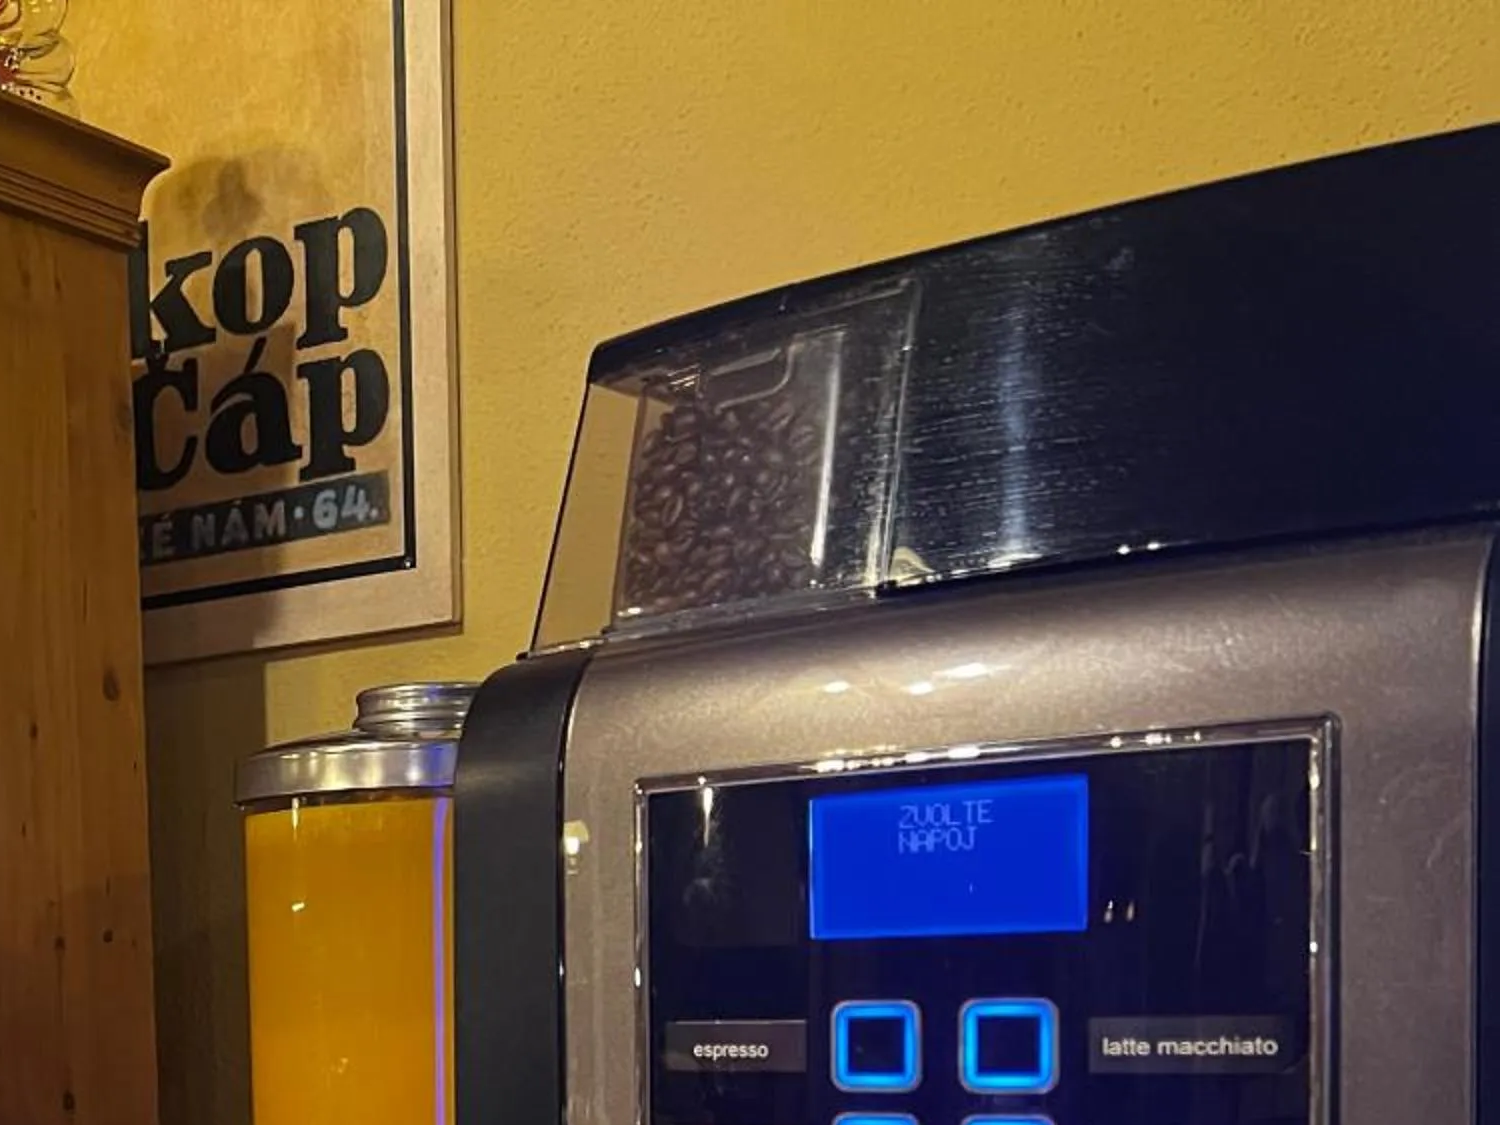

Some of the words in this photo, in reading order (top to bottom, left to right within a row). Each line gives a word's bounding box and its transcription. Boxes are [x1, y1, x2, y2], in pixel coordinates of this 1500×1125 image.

[693, 1043, 770, 1061] espresso
[1102, 1036, 1151, 1056] latte
[1157, 1036, 1279, 1056] macchiato
